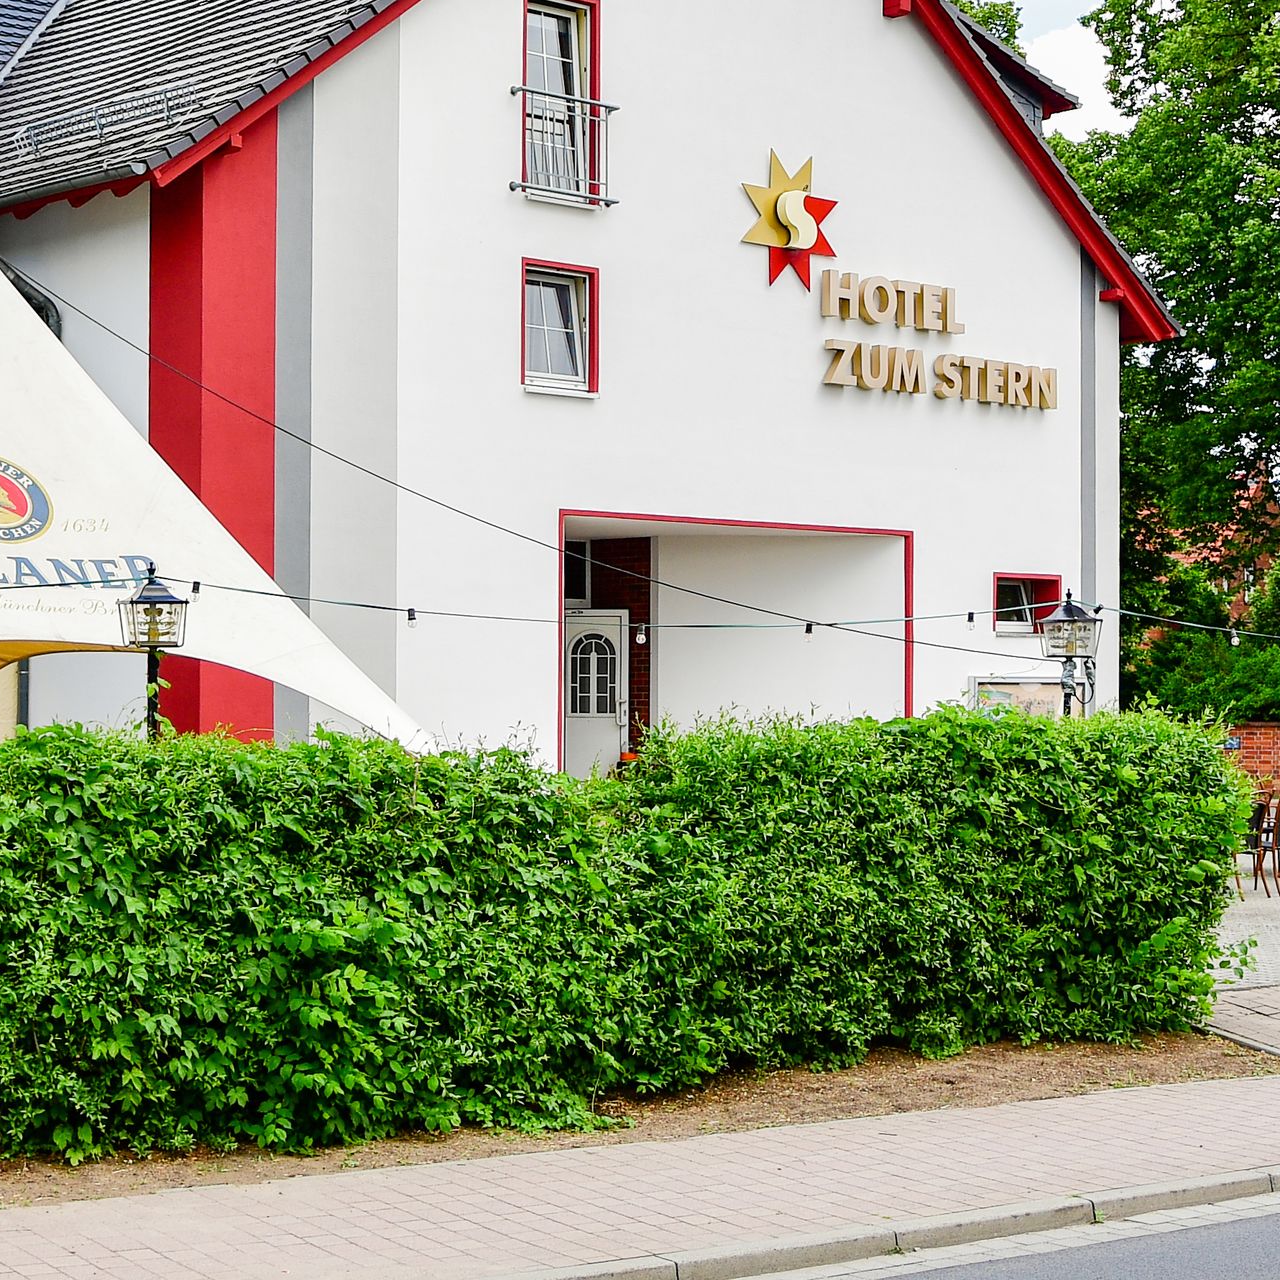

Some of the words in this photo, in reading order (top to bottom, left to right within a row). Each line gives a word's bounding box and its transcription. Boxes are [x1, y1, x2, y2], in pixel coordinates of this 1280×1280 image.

[822, 268, 966, 334] HOTEL
[823, 339, 927, 394] ZUM
[934, 353, 1058, 410] STERN
[61, 517, 111, 533] 1634
